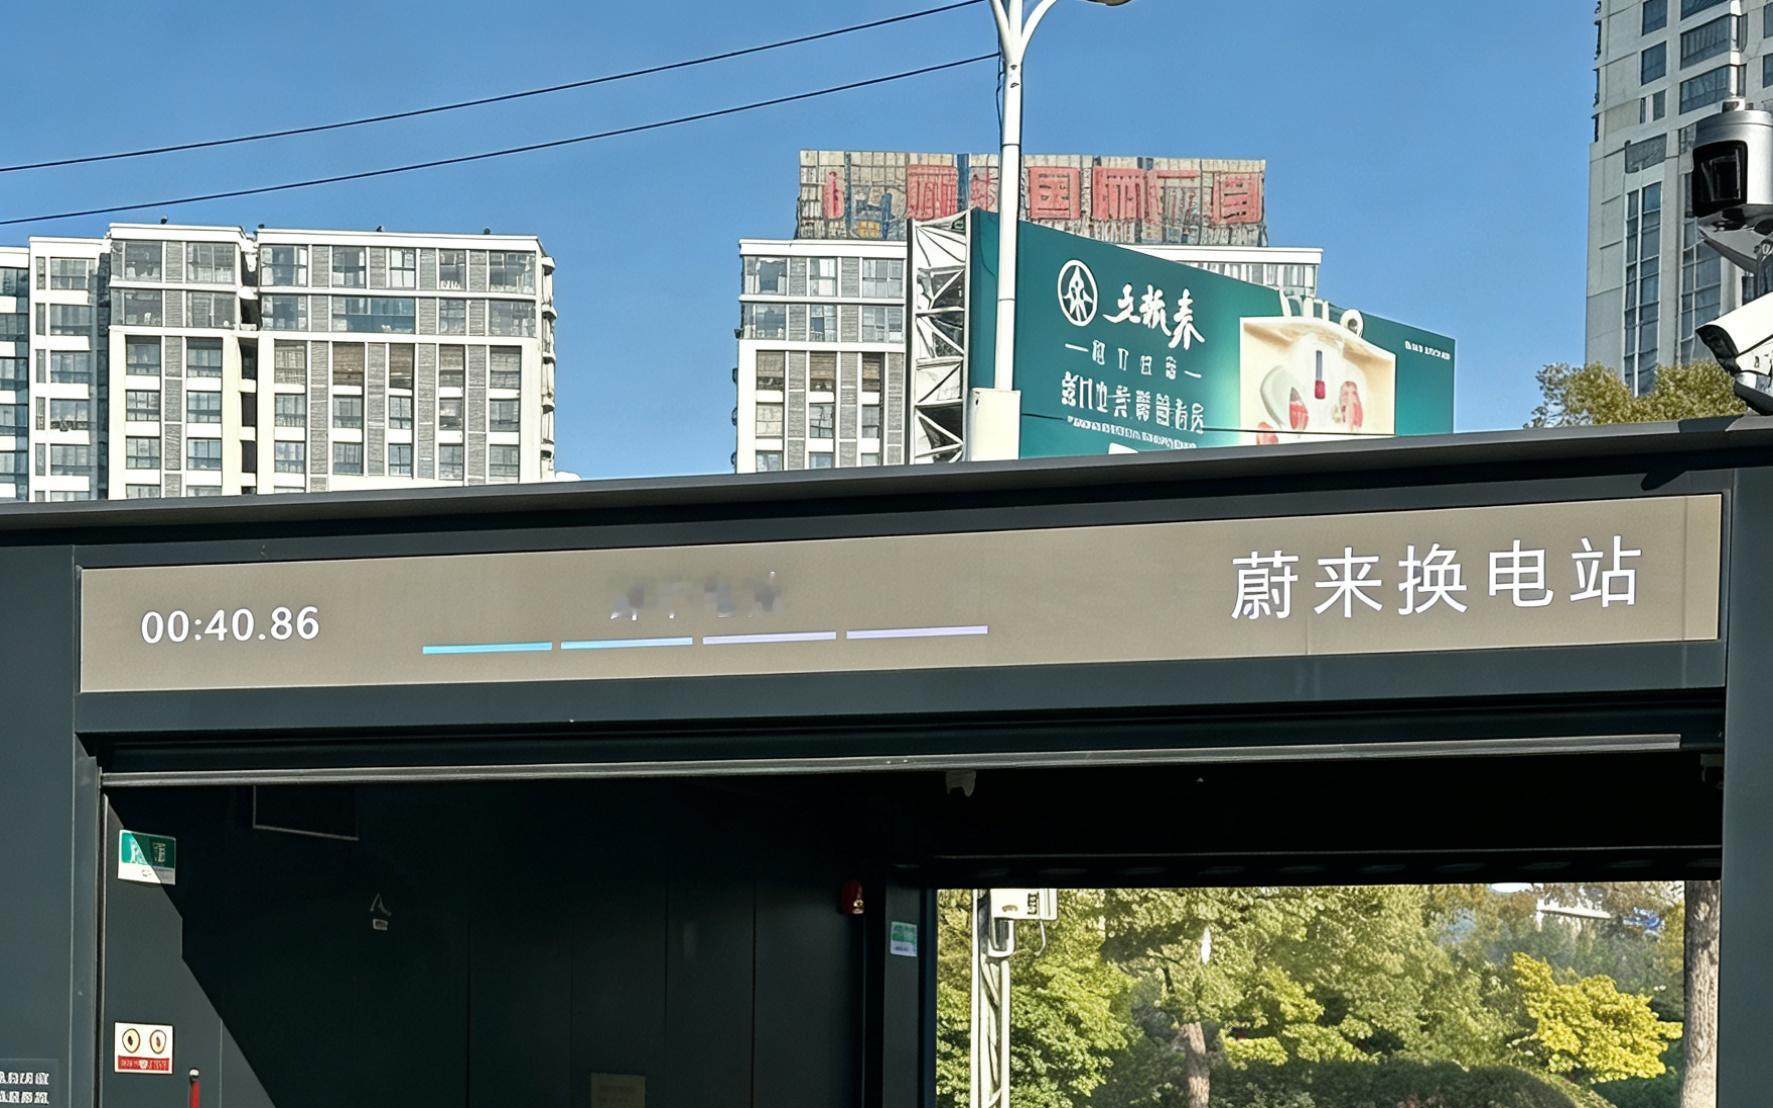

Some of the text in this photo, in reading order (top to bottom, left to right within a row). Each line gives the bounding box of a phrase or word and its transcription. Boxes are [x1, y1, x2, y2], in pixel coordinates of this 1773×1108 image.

[1231, 535, 1641, 620] 蔚来换电站
[141, 606, 319, 644] 00:40.86
